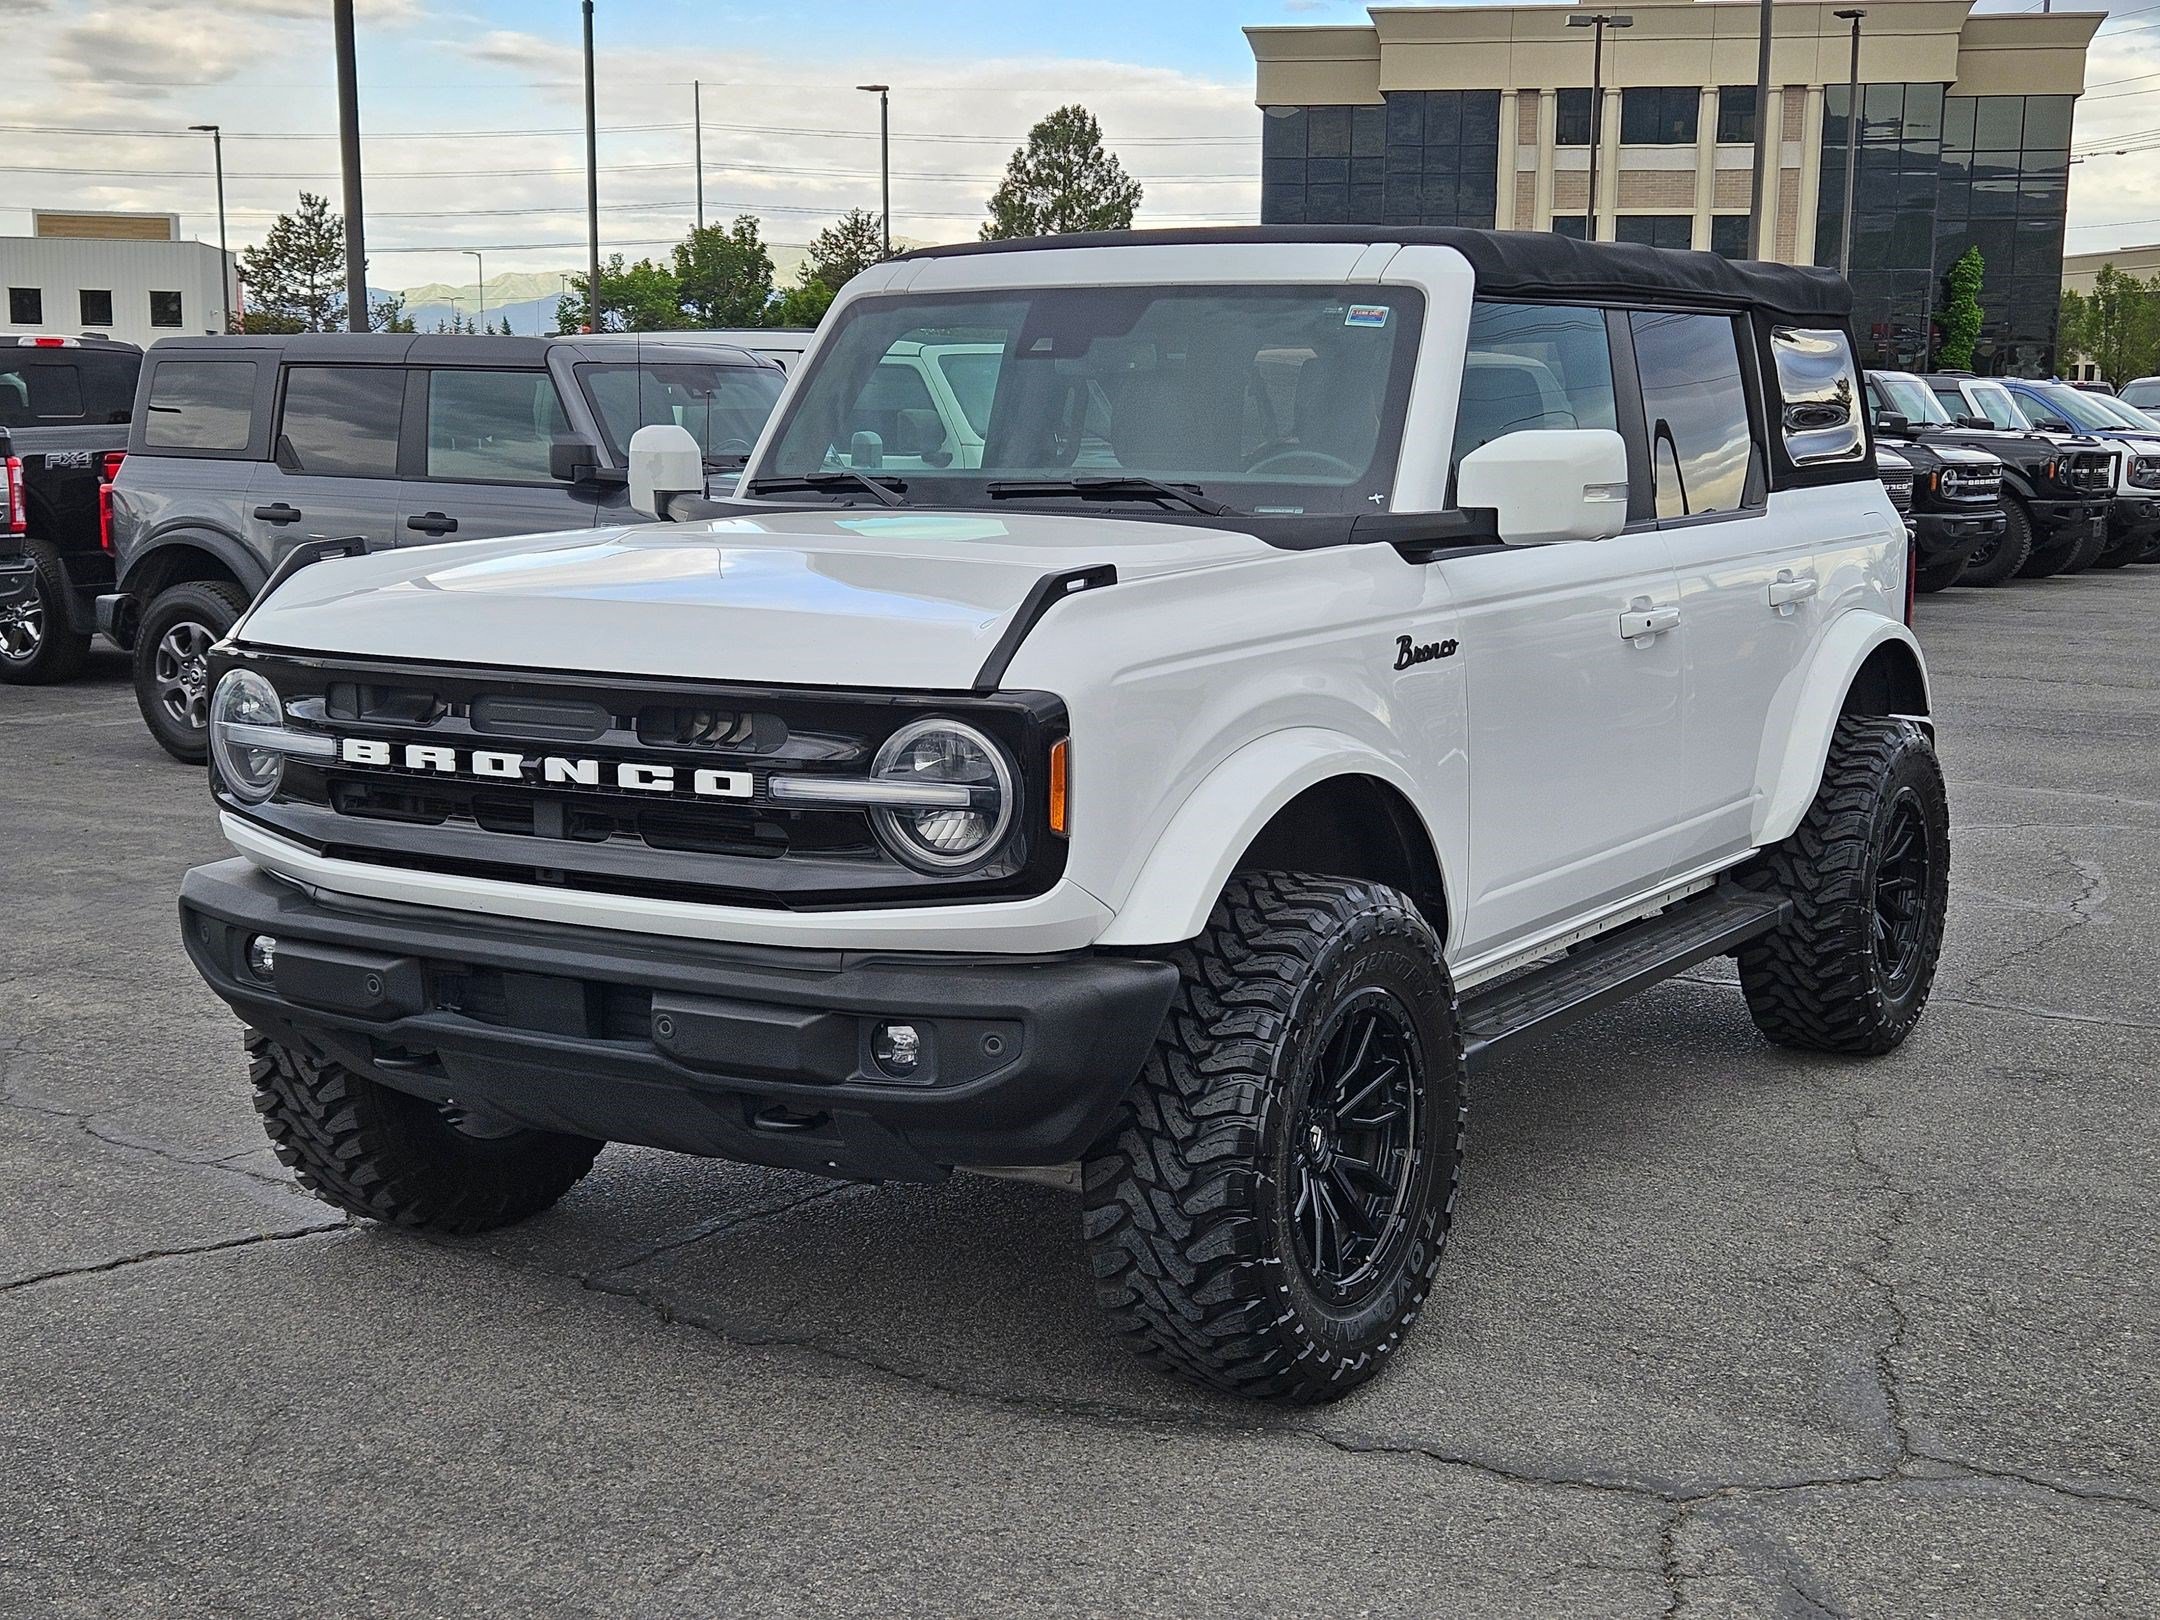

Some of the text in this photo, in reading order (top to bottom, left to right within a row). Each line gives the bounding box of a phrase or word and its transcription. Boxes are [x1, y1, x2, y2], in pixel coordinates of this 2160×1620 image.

[45, 452, 92, 470] FX4
[1394, 634, 1459, 671] Bronco
[343, 738, 753, 798] BRONCO
